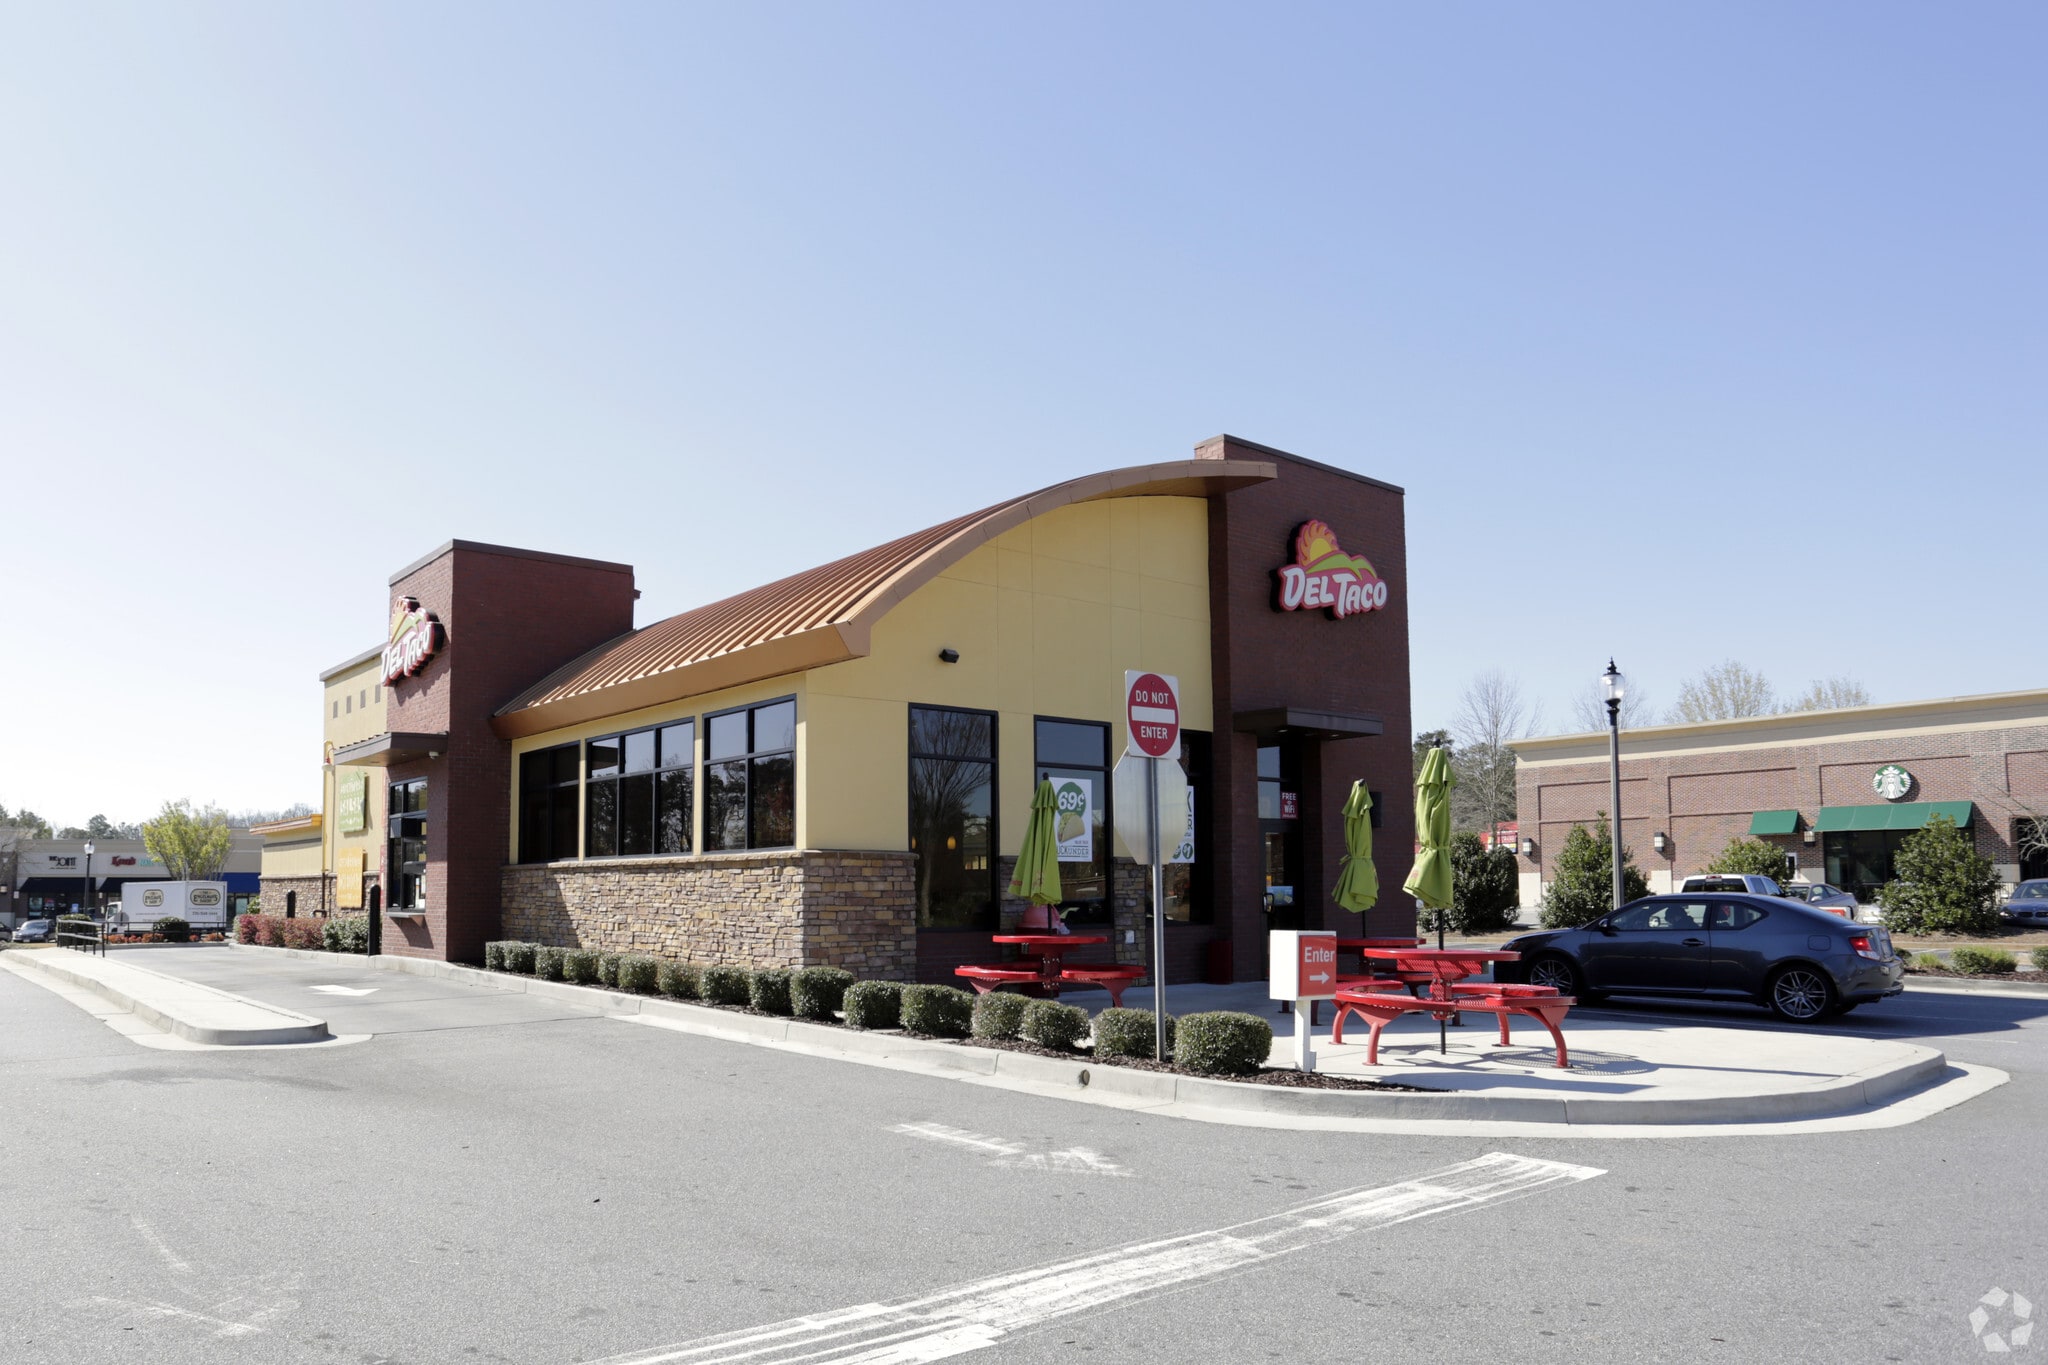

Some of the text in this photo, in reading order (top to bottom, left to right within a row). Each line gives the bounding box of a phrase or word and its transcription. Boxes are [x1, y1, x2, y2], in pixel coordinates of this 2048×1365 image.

[1283, 567, 1387, 618] DEL TACO
[381, 624, 431, 684] DEL TACO
[1135, 689, 1169, 704] DO NOT
[1140, 725, 1168, 740] ENTER
[1282, 792, 1297, 801] FREE
[1304, 946, 1335, 963] Enter
